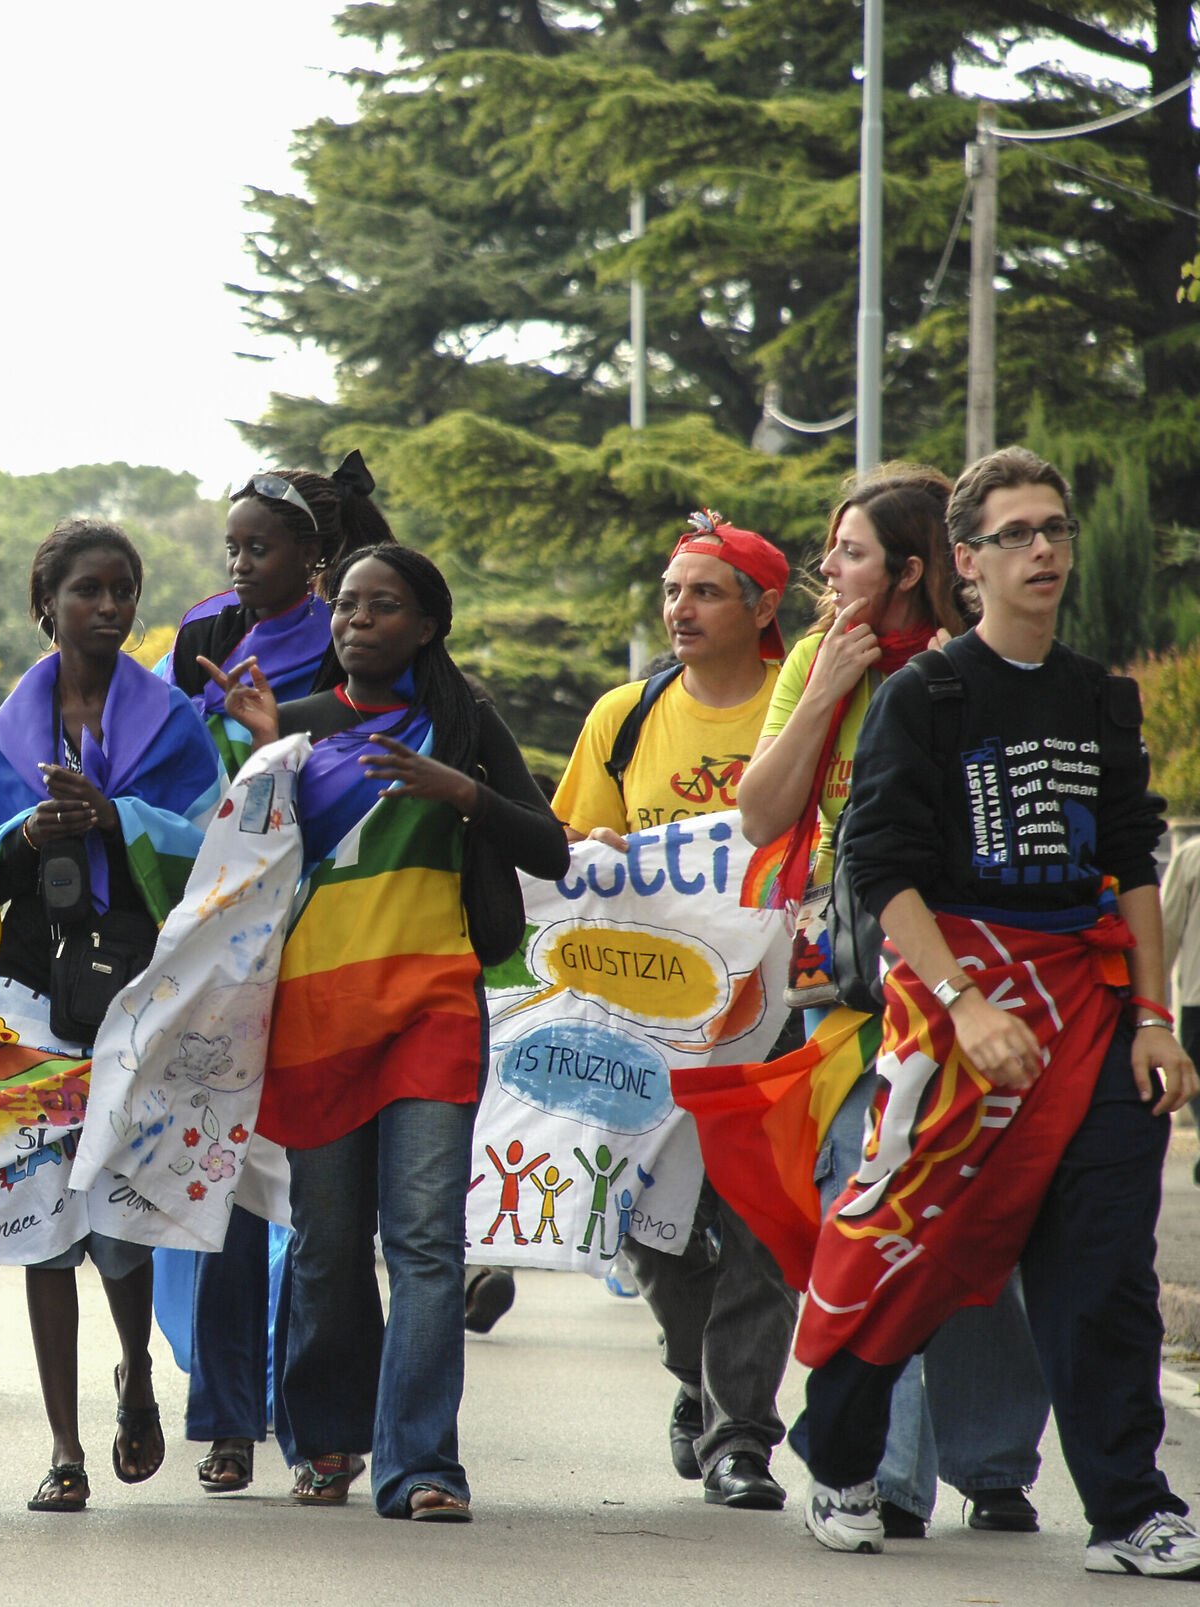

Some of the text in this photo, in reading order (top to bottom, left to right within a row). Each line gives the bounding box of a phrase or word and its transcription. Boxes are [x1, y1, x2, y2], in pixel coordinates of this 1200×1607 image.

[1004, 740, 1039, 756] solo
[1008, 759, 1049, 777] sono
[1011, 778, 1042, 798] folli
[966, 763, 989, 857] ANIMALISTI
[983, 764, 1006, 850] ITALIANI
[1015, 799, 1061, 818] di pot
[1018, 843, 1030, 857] il
[560, 942, 687, 984] GIUSTIZIA
[514, 1044, 657, 1100] ISTRUZIONE
